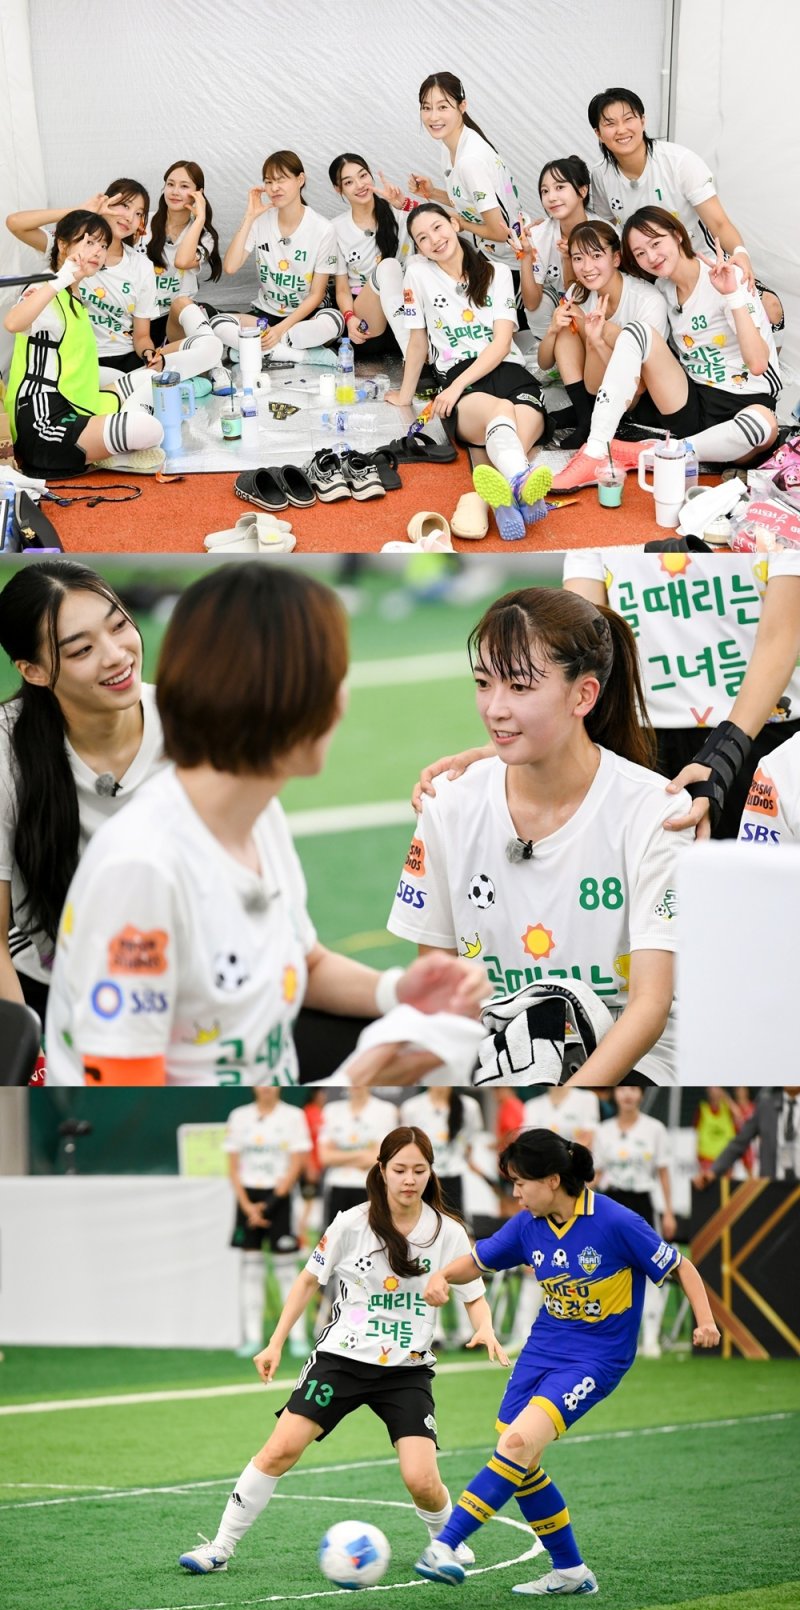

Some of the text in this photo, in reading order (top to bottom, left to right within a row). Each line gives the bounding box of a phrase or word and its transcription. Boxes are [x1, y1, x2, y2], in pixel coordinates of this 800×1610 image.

[294, 249, 307, 262] 21
[122, 282, 131, 294] 5
[691, 314, 708, 331] 33
[618, 574, 760, 638] 골때리는
[648, 639, 748, 698] 그녀들
[741, 822, 781, 845] SBS
[396, 879, 428, 909] SBS
[579, 876, 623, 911] 88
[312, 1250, 327, 1266] SBS
[365, 1319, 414, 1349] 그녀들
[303, 1379, 335, 1408] 13
